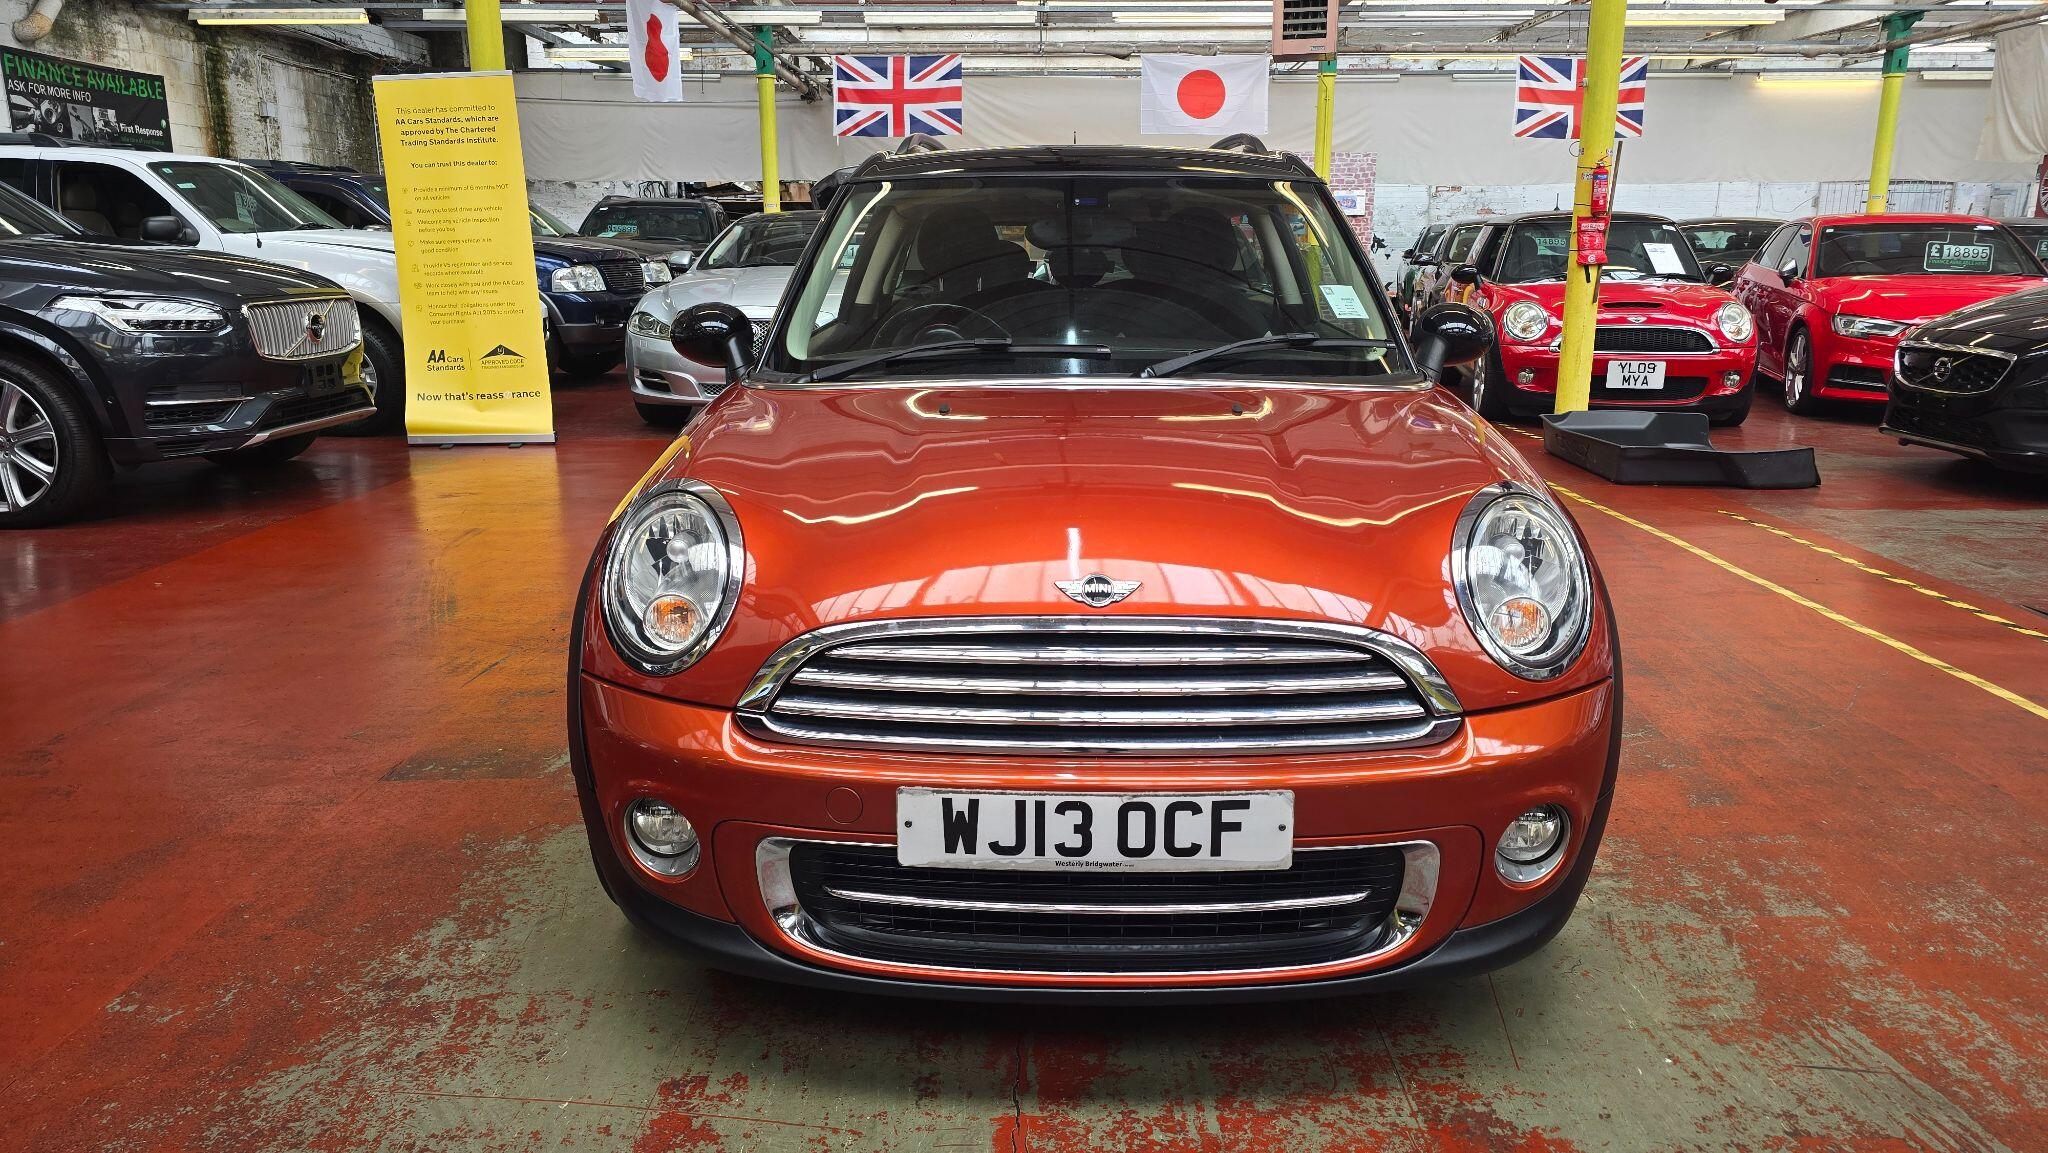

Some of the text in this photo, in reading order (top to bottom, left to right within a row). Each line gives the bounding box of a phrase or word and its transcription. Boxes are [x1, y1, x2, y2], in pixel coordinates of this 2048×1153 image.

[3, 53, 164, 100] FINANCE AVAILABLE
[7, 79, 92, 102] ASK FOR MORE INFO
[119, 123, 163, 137] First Response
[401, 128, 434, 136] approved
[427, 350, 446, 363] AA
[427, 364, 465, 372] Standards
[1619, 363, 1656, 374] YL09
[1622, 375, 1648, 386] MYA
[417, 393, 442, 401] Now
[445, 392, 474, 401] that's
[1085, 583, 1111, 593] MINI
[942, 797, 1251, 858] WJ13 OCF
[1055, 860, 1084, 868] Westerly
[1085, 860, 1123, 868] Bridgwater
